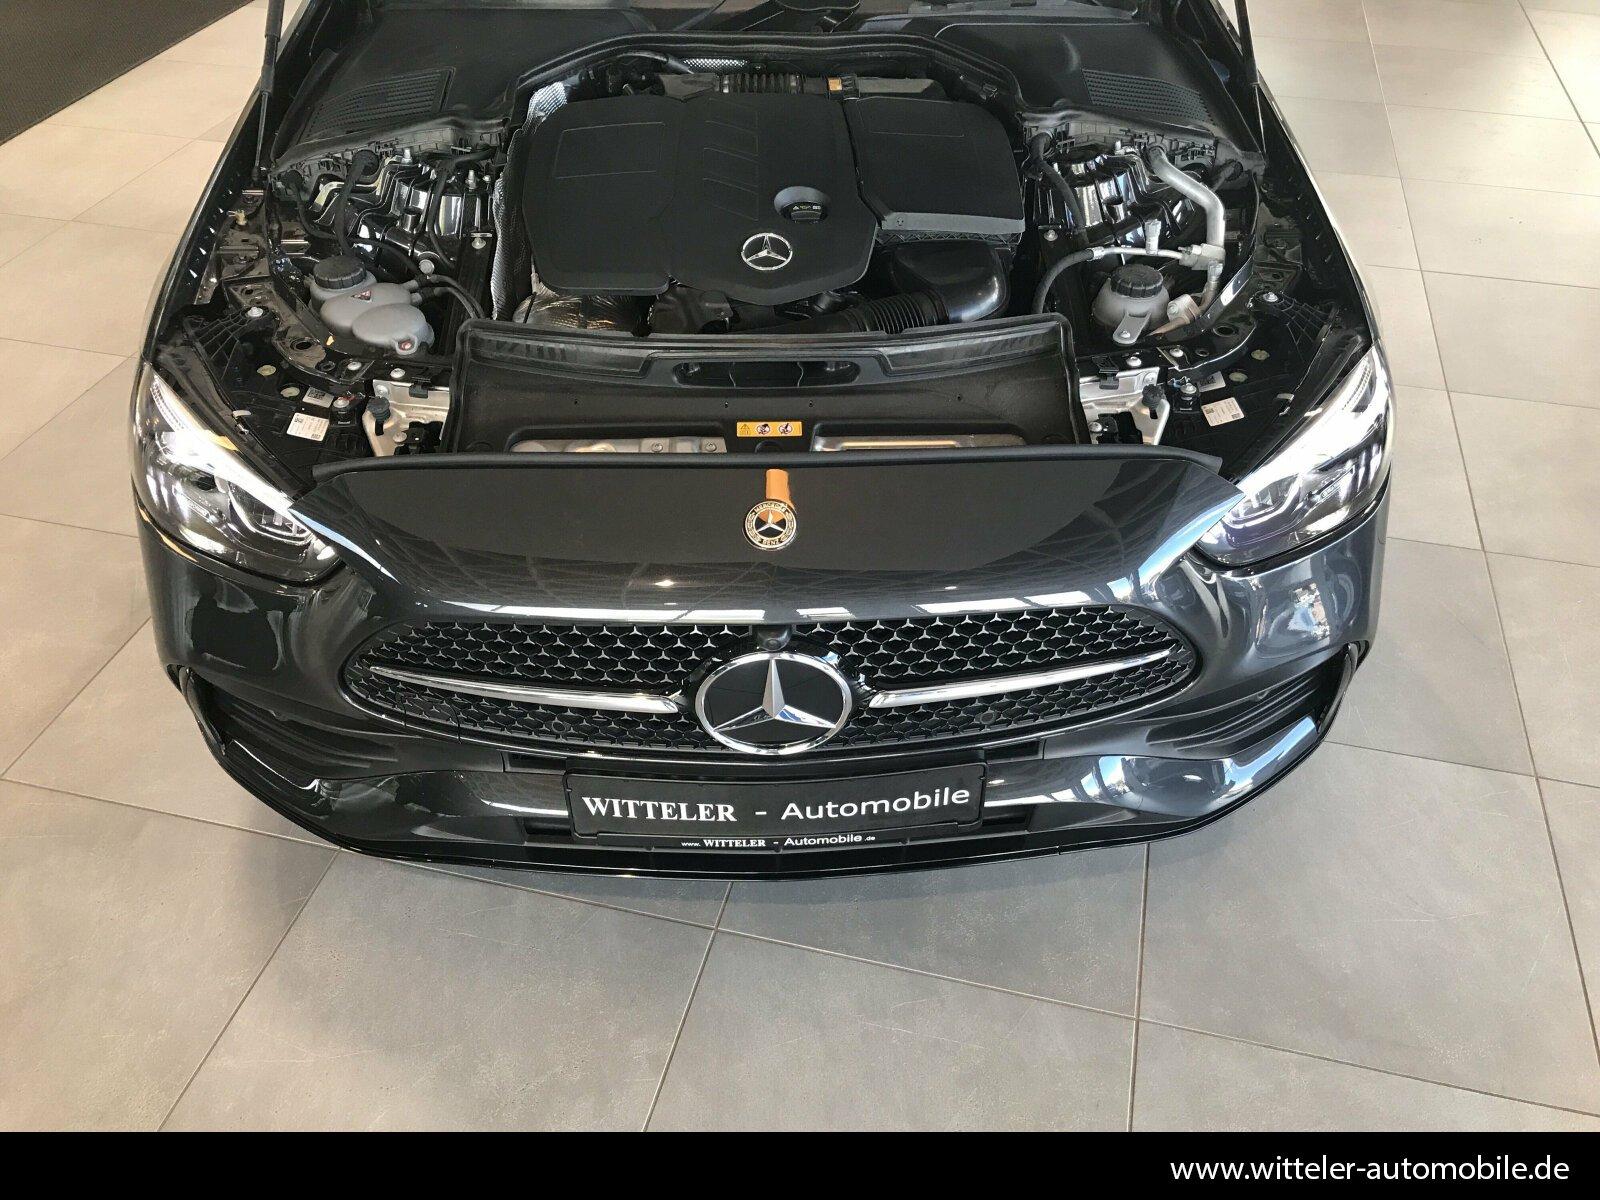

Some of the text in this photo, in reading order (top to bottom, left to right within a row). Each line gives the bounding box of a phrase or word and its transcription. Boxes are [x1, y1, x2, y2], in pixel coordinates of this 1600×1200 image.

[582, 796, 737, 822] WITTELER
[780, 786, 970, 821] Automobile
[703, 839, 766, 848] WITTELER
[784, 834, 862, 846] Automobile
